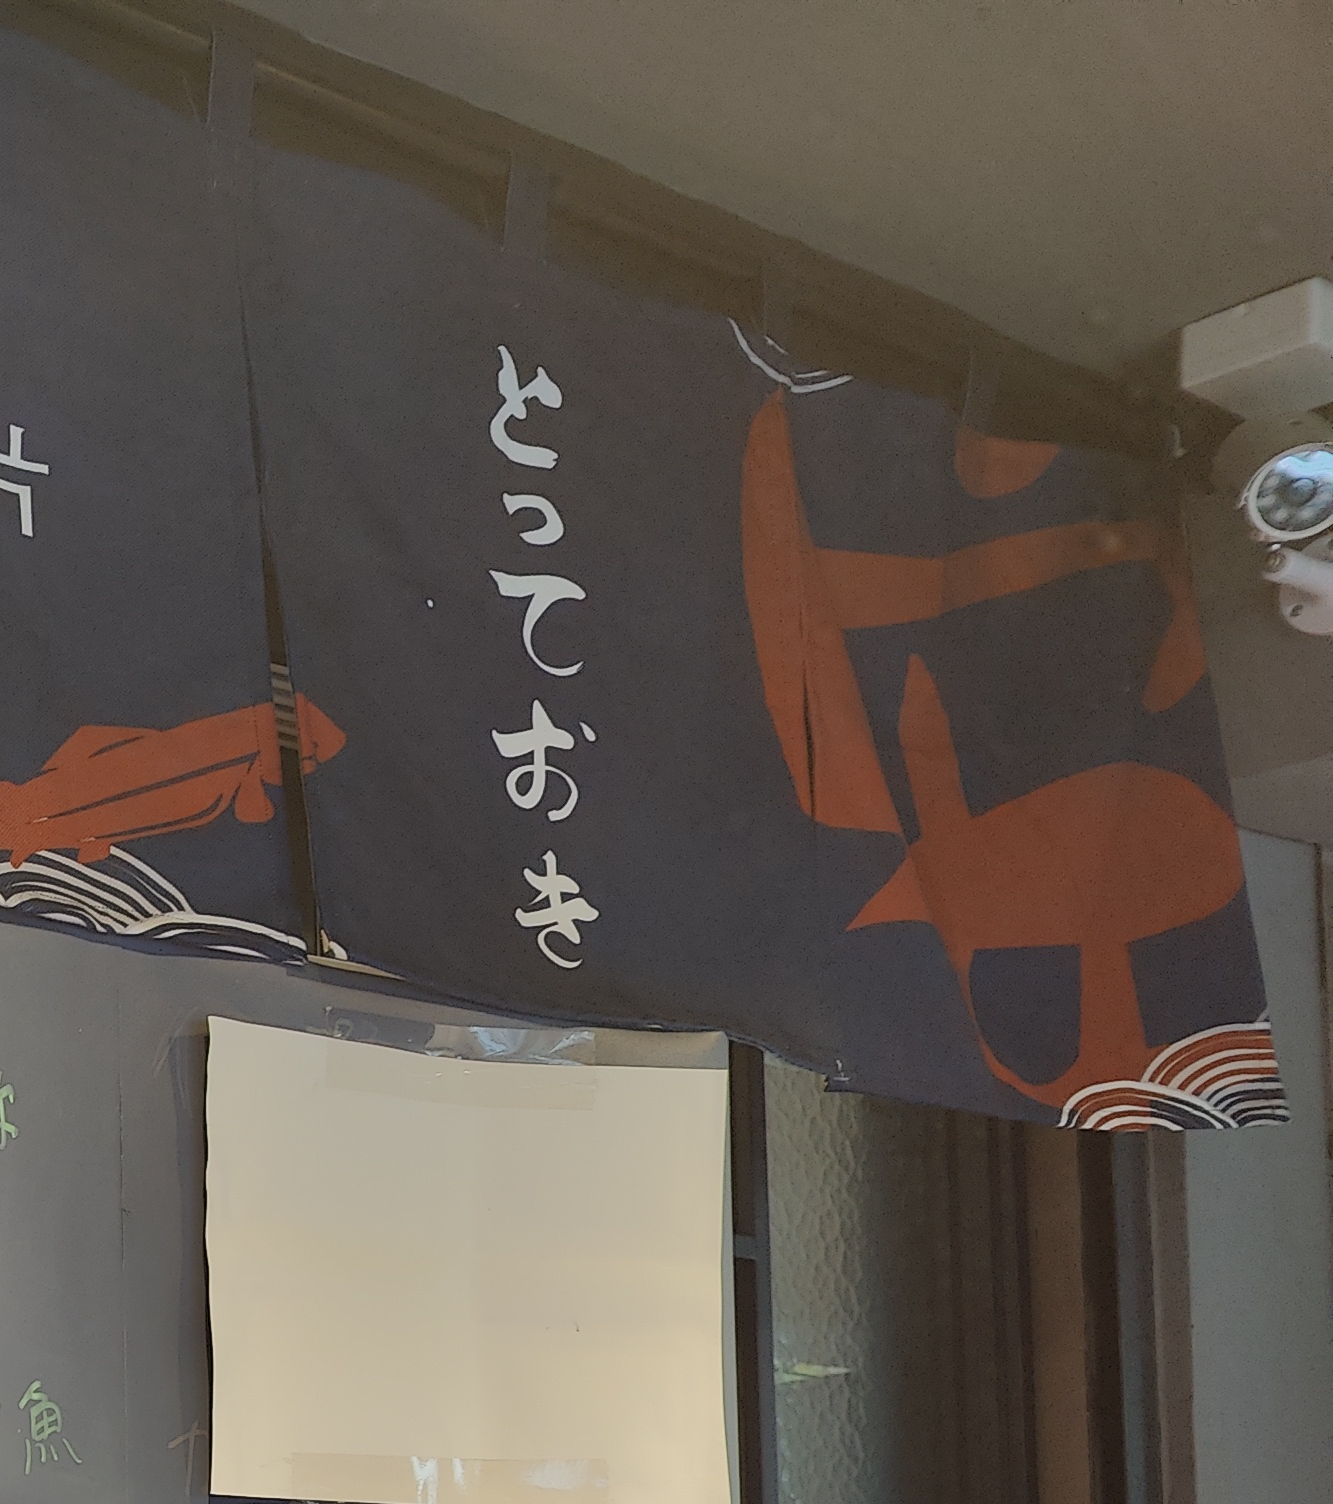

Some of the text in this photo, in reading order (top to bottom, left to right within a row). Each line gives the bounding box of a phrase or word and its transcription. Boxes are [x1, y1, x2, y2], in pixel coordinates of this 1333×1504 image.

[489, 345, 599, 969] とっておき
